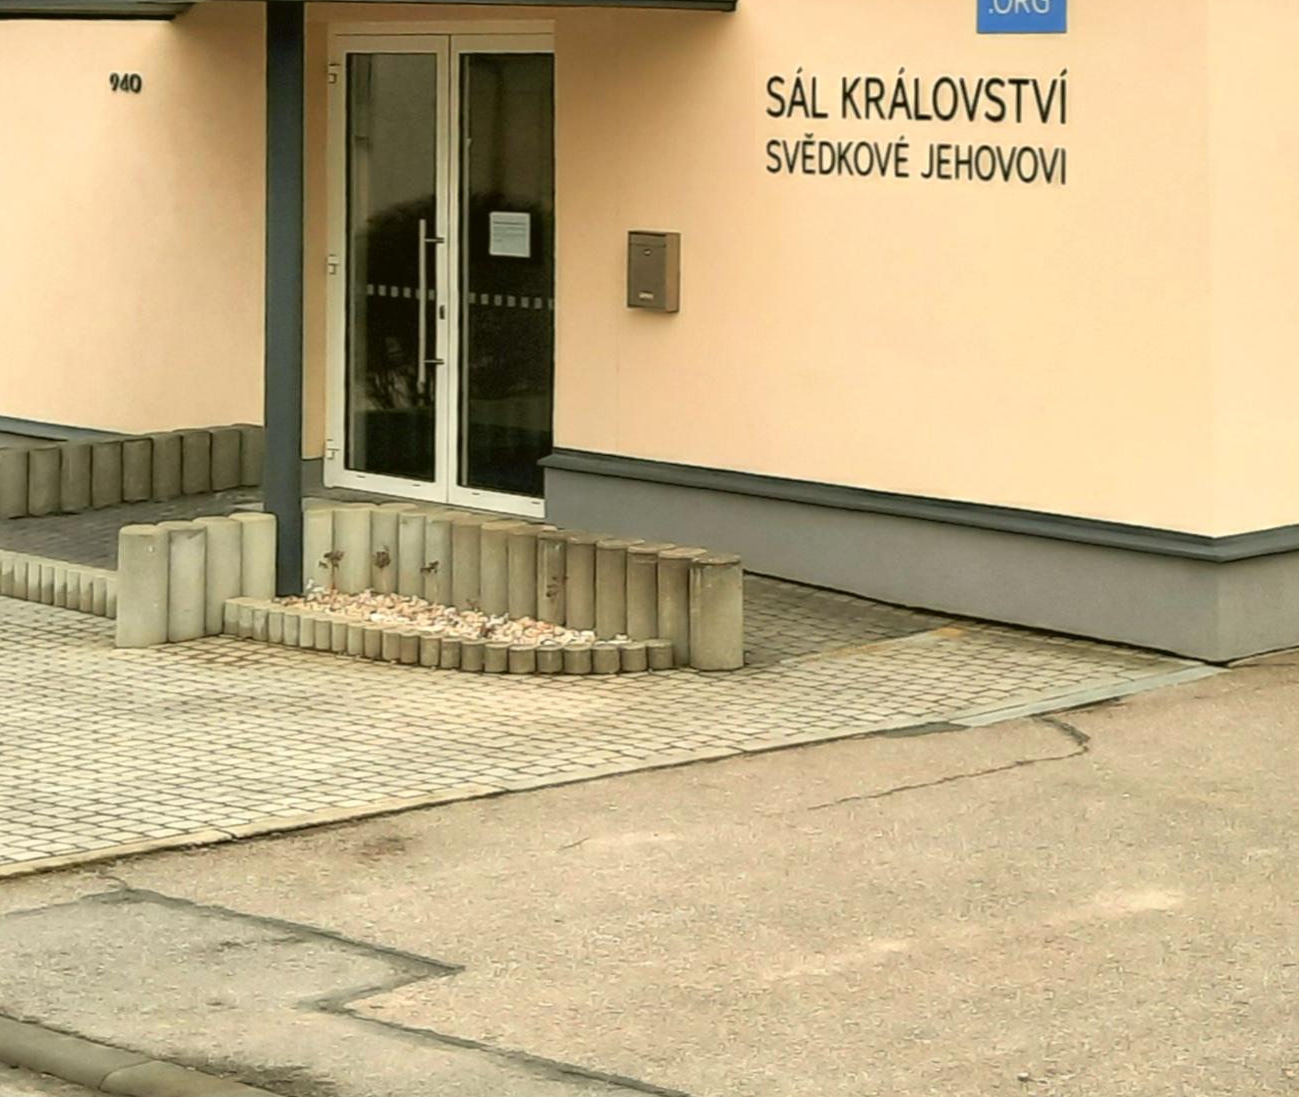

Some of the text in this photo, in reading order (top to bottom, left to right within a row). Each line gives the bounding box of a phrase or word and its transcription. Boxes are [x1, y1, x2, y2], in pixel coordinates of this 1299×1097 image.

[109, 72, 142, 94] 940
[766, 67, 1068, 124] SÁL KRÁLOVSTVÍ
[766, 133, 1067, 185] SVĚDKOVÉ JEHOVOVI
